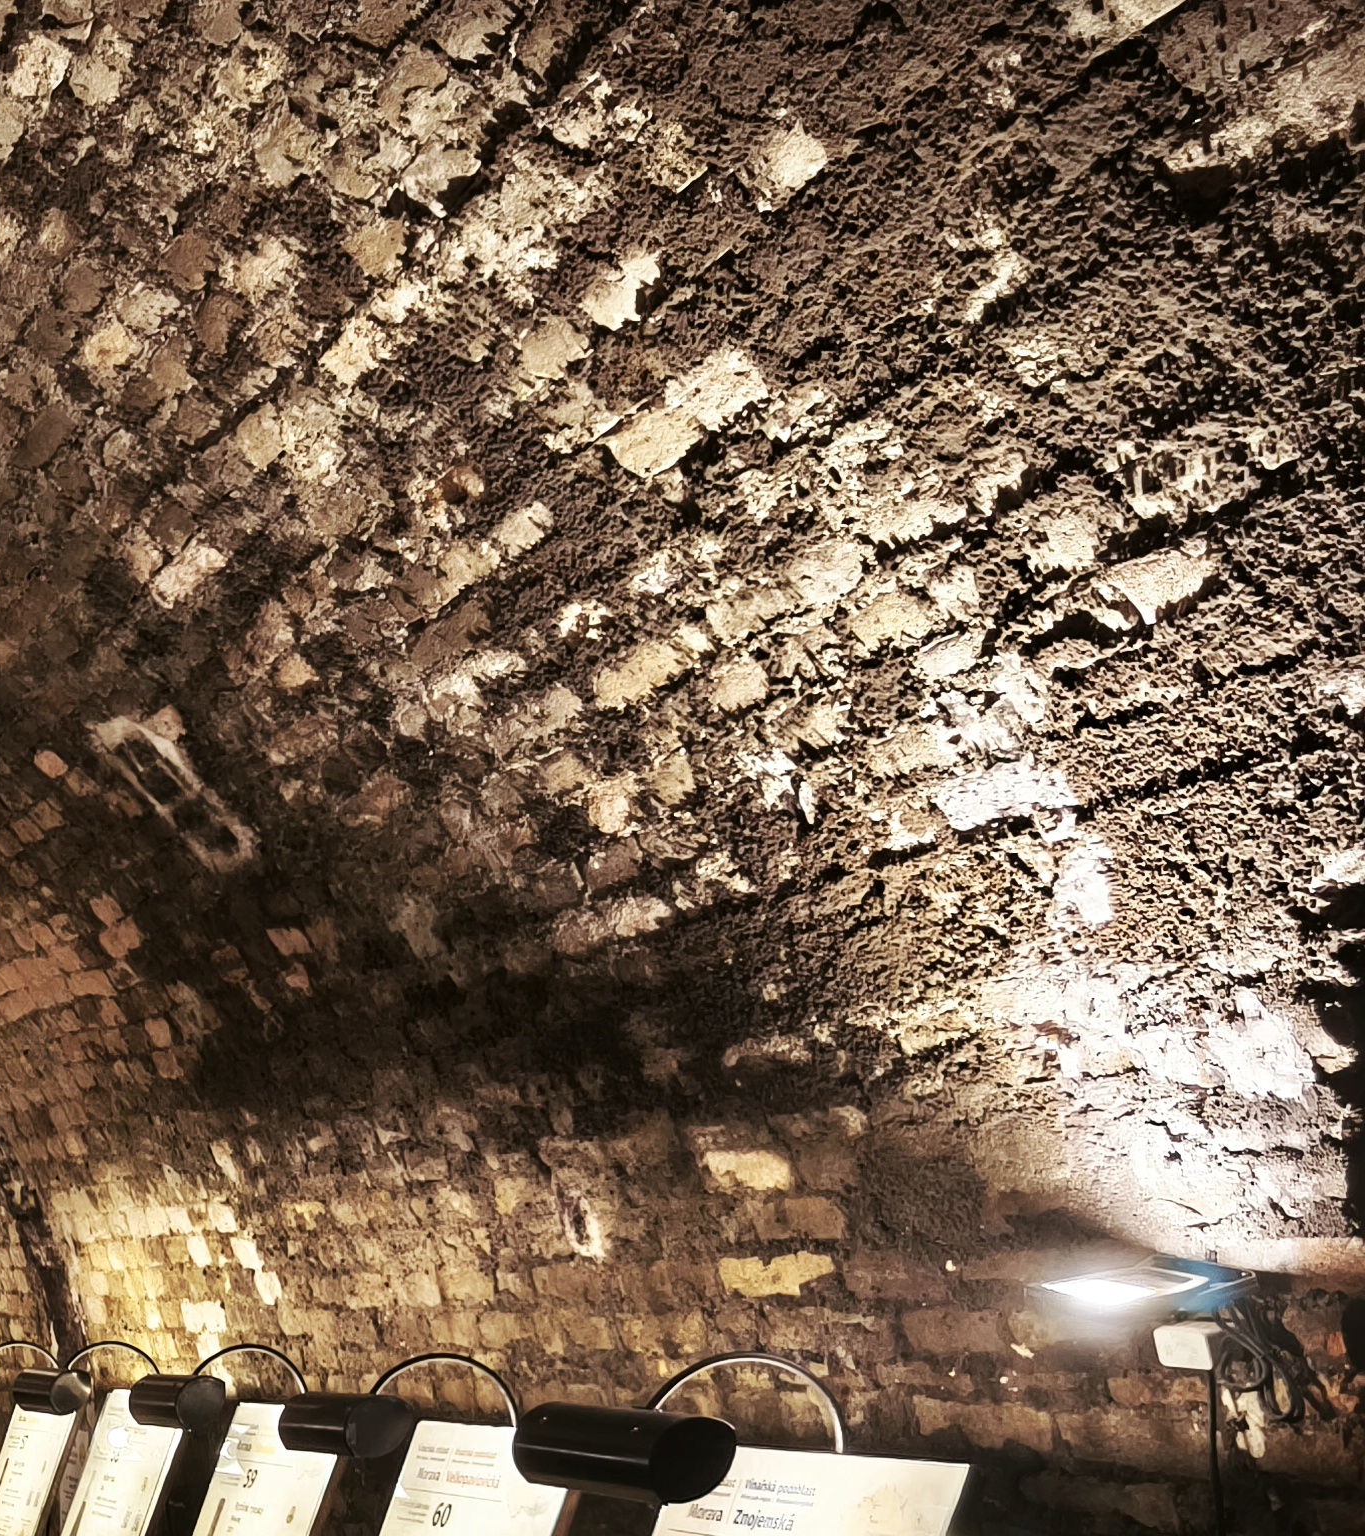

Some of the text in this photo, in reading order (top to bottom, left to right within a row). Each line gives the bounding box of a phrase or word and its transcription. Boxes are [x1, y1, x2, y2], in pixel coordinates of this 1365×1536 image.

[242, 1468, 258, 1489] 59
[432, 1502, 452, 1528] 60
[688, 1503, 723, 1522] Morava
[733, 1509, 795, 1532] Znojemská
